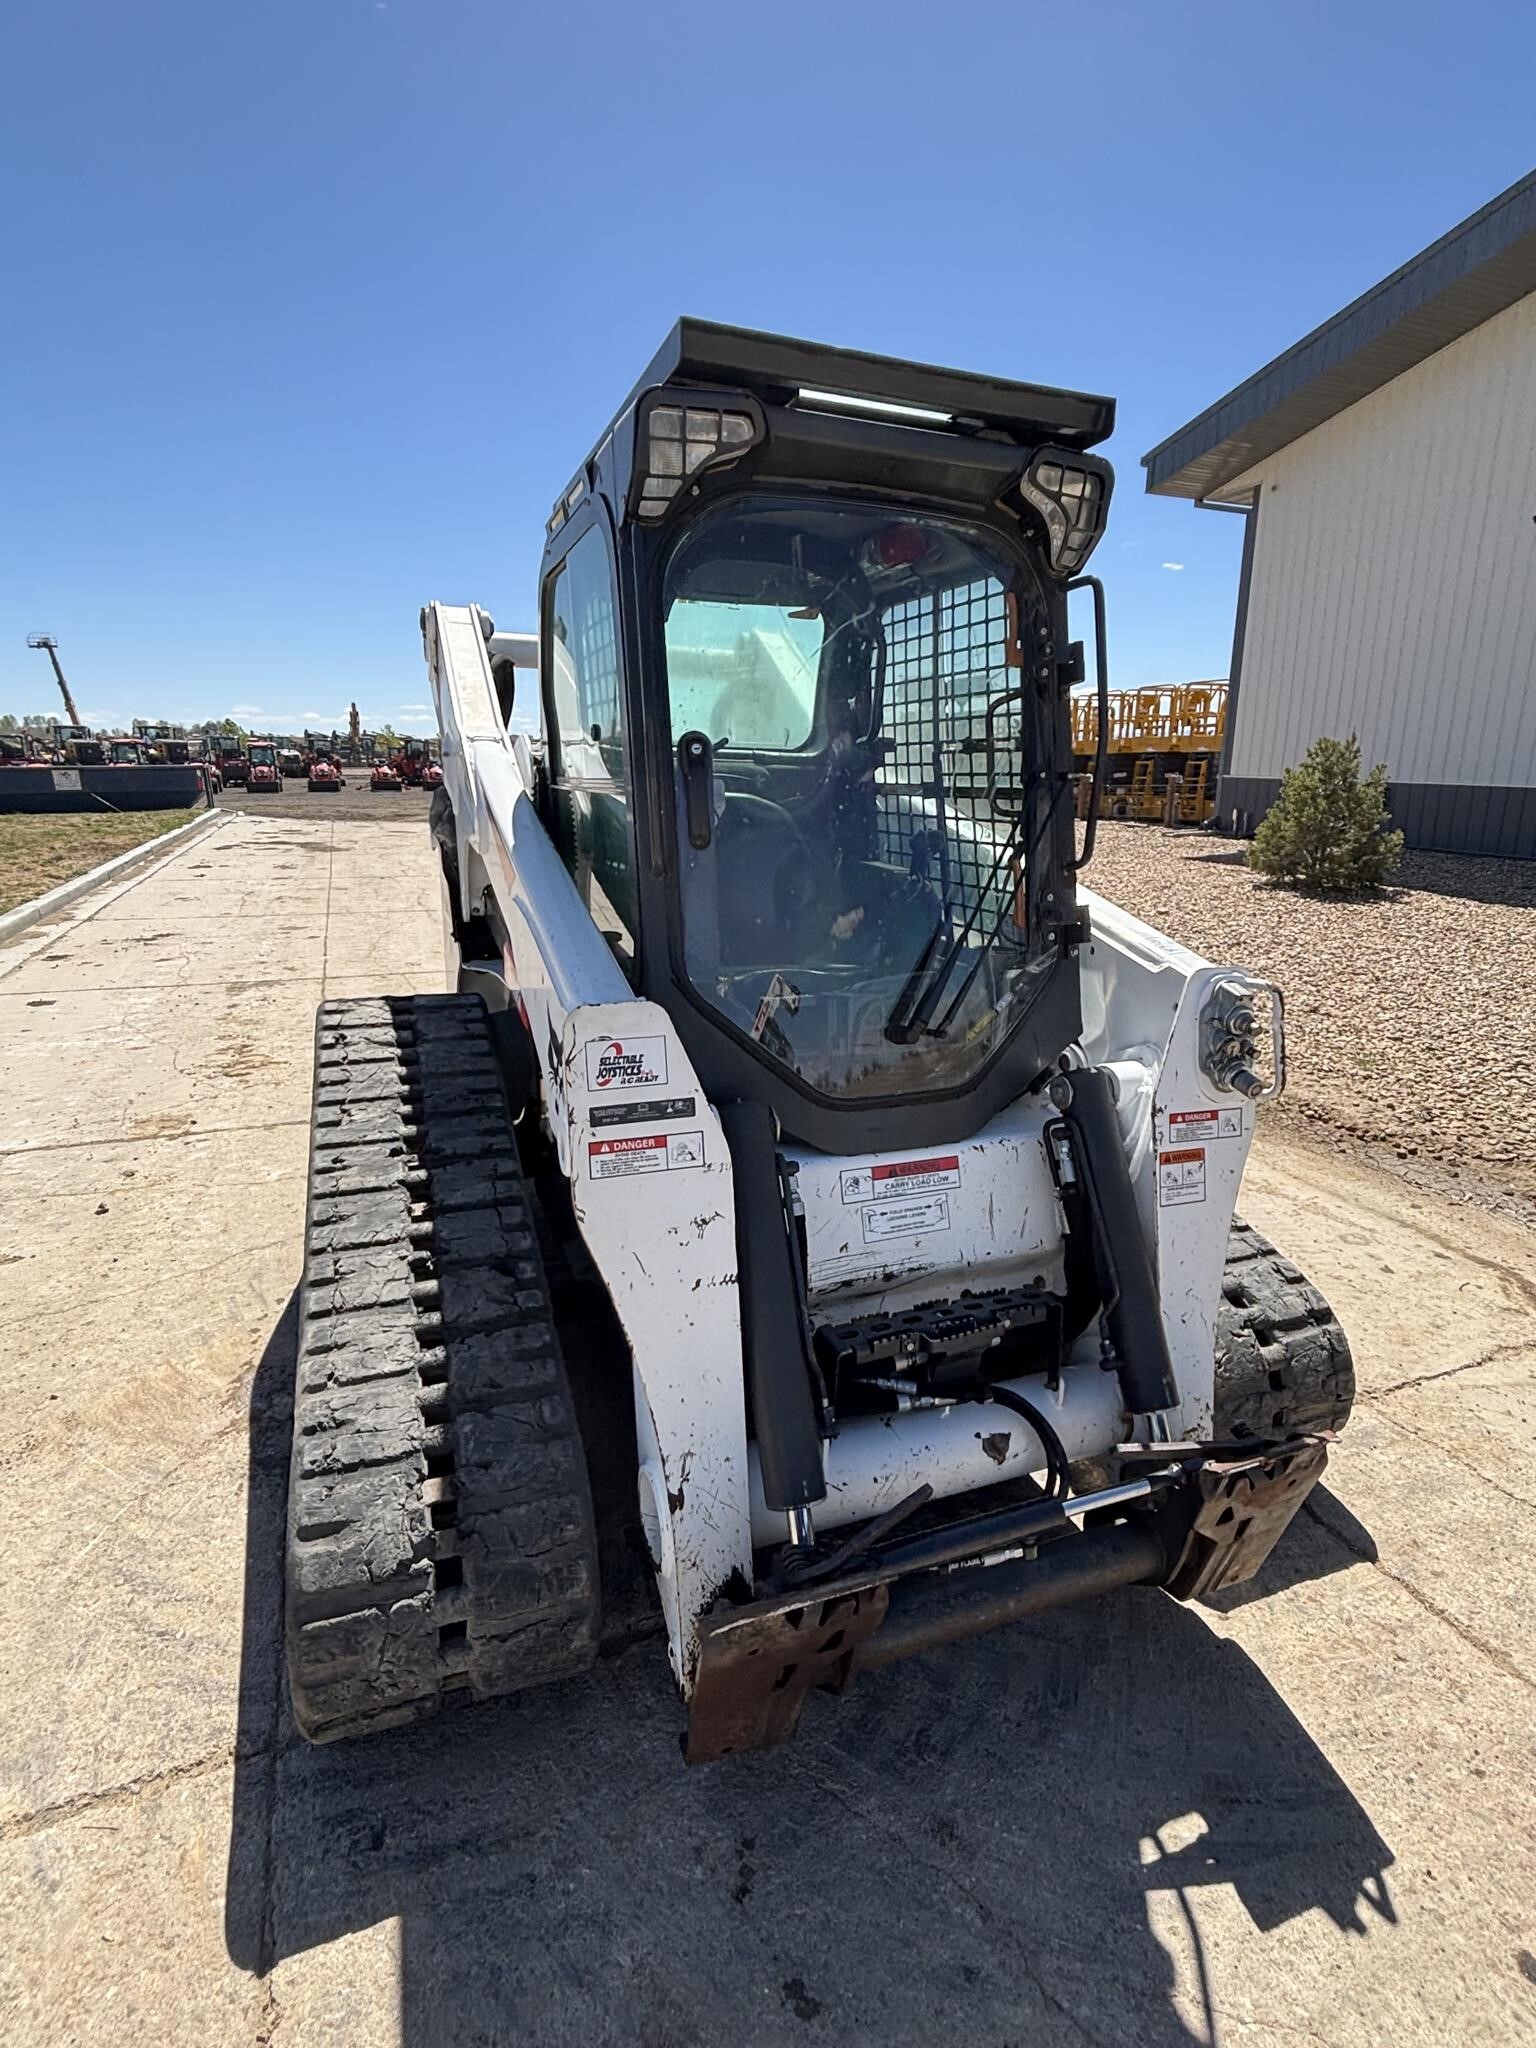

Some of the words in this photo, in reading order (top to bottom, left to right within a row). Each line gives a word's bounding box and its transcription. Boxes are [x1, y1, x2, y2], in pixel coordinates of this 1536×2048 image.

[599, 1054, 644, 1067] SELECTABLE
[596, 1064, 642, 1079] JOYSTICKS
[635, 1075, 659, 1083] READY
[1185, 1113, 1211, 1121] DANGER
[613, 1139, 655, 1151] DANGER
[1172, 1150, 1201, 1161] WARNING
[884, 1182, 909, 1190] CARRY
[911, 1179, 931, 1187] LOAD
[933, 1176, 949, 1184] LOW
